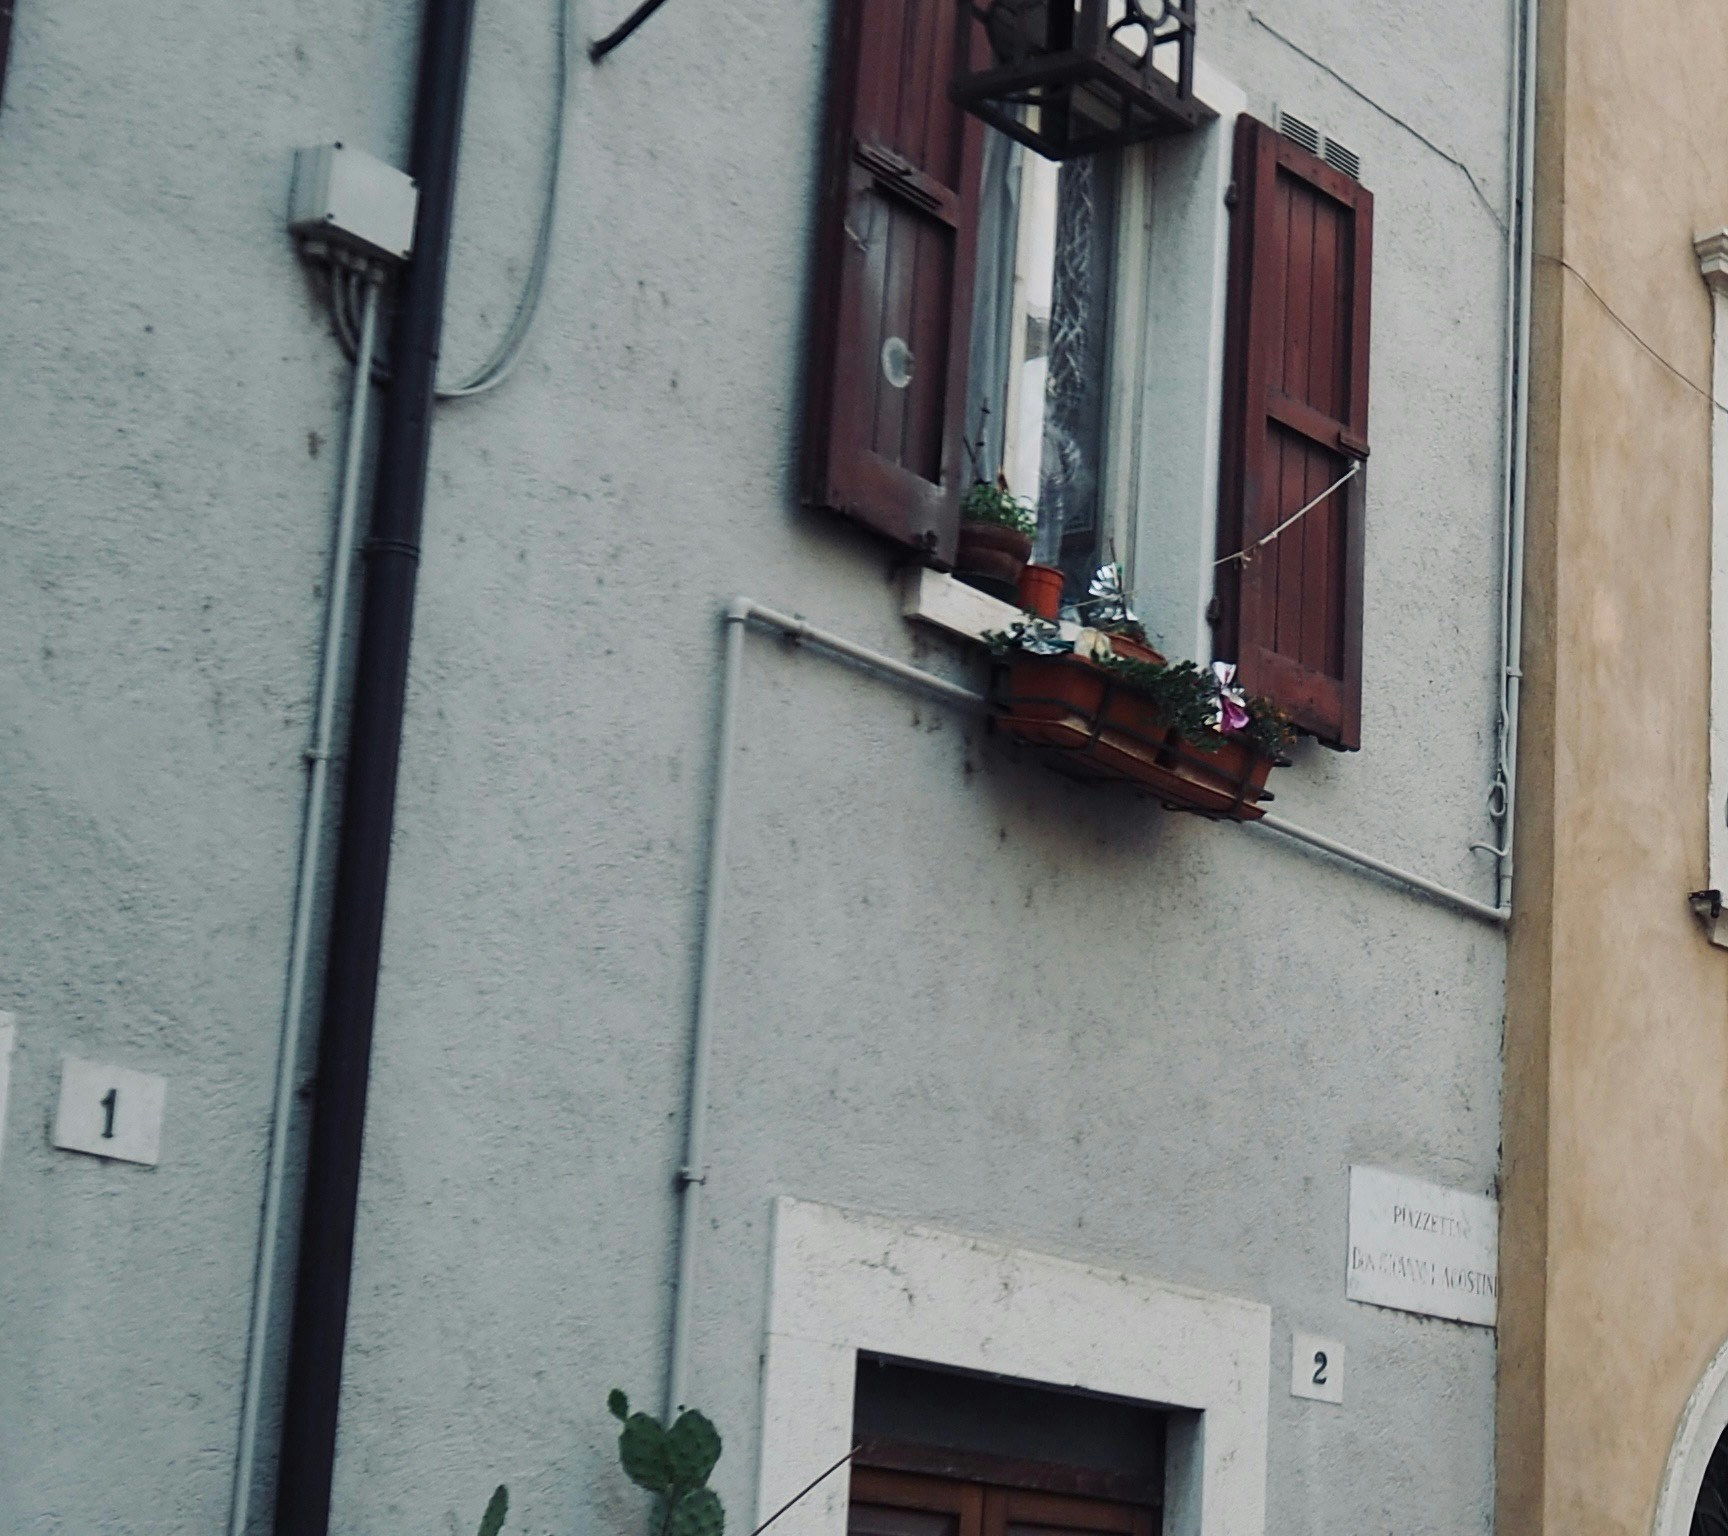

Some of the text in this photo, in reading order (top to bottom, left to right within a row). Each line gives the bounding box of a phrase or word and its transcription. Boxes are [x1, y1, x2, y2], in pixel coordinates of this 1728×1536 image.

[100, 1088, 117, 1139] 1
[1393, 1205, 1469, 1239] PIAZZETTA
[1312, 1351, 1328, 1385] 2
